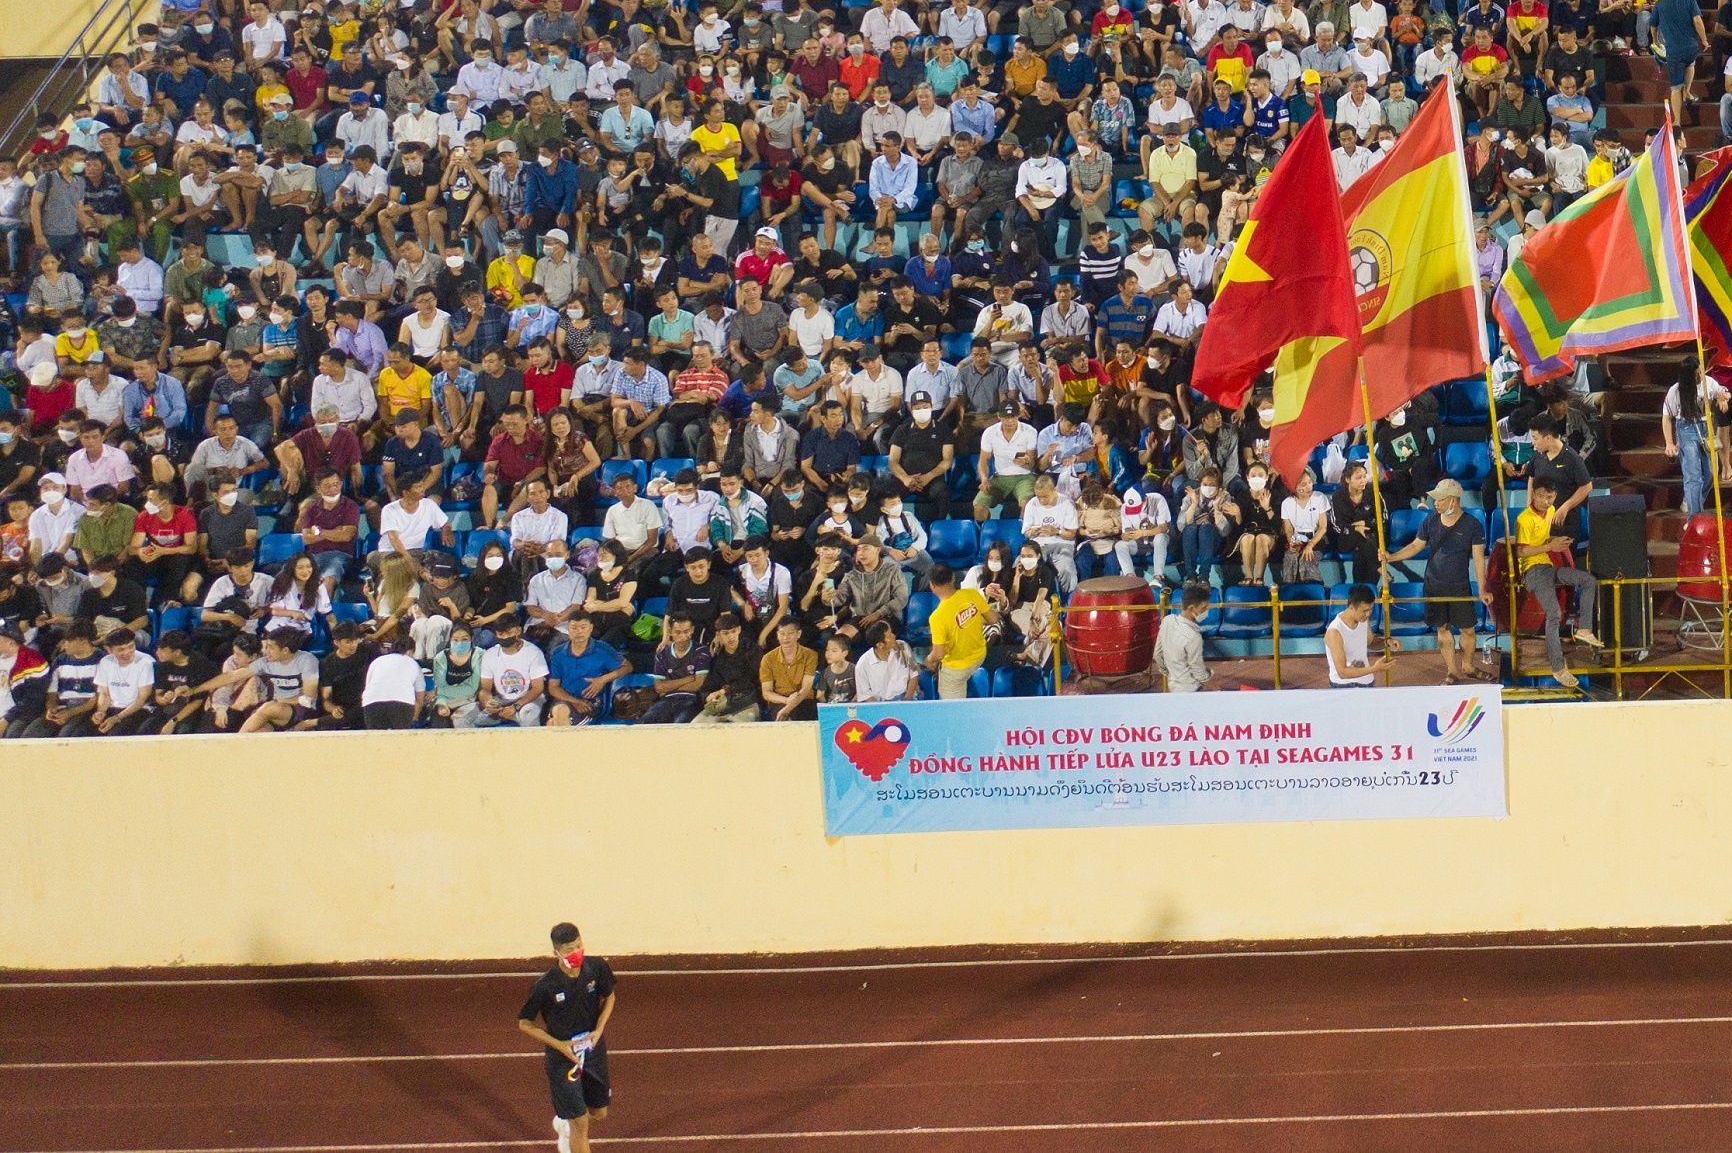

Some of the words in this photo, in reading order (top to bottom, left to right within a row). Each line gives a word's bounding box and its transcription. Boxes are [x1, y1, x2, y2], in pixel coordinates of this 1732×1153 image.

[1006, 726, 1045, 748] HỘI
[1052, 728, 1093, 744] CĐV
[1101, 724, 1162, 743] BÓNG
[1169, 722, 1198, 741] ĐÁ
[1205, 724, 1251, 740] NAM
[1260, 722, 1312, 742] ĐỊNH
[909, 752, 972, 774] ĐỒNG
[979, 751, 1039, 772] HÀNH
[1047, 748, 1089, 770] TIẾP
[1096, 747, 1135, 768] LỬA
[1190, 747, 1230, 766] LÀO
[1237, 749, 1269, 768] TẠI
[1277, 746, 1383, 763] SEAGAMES
